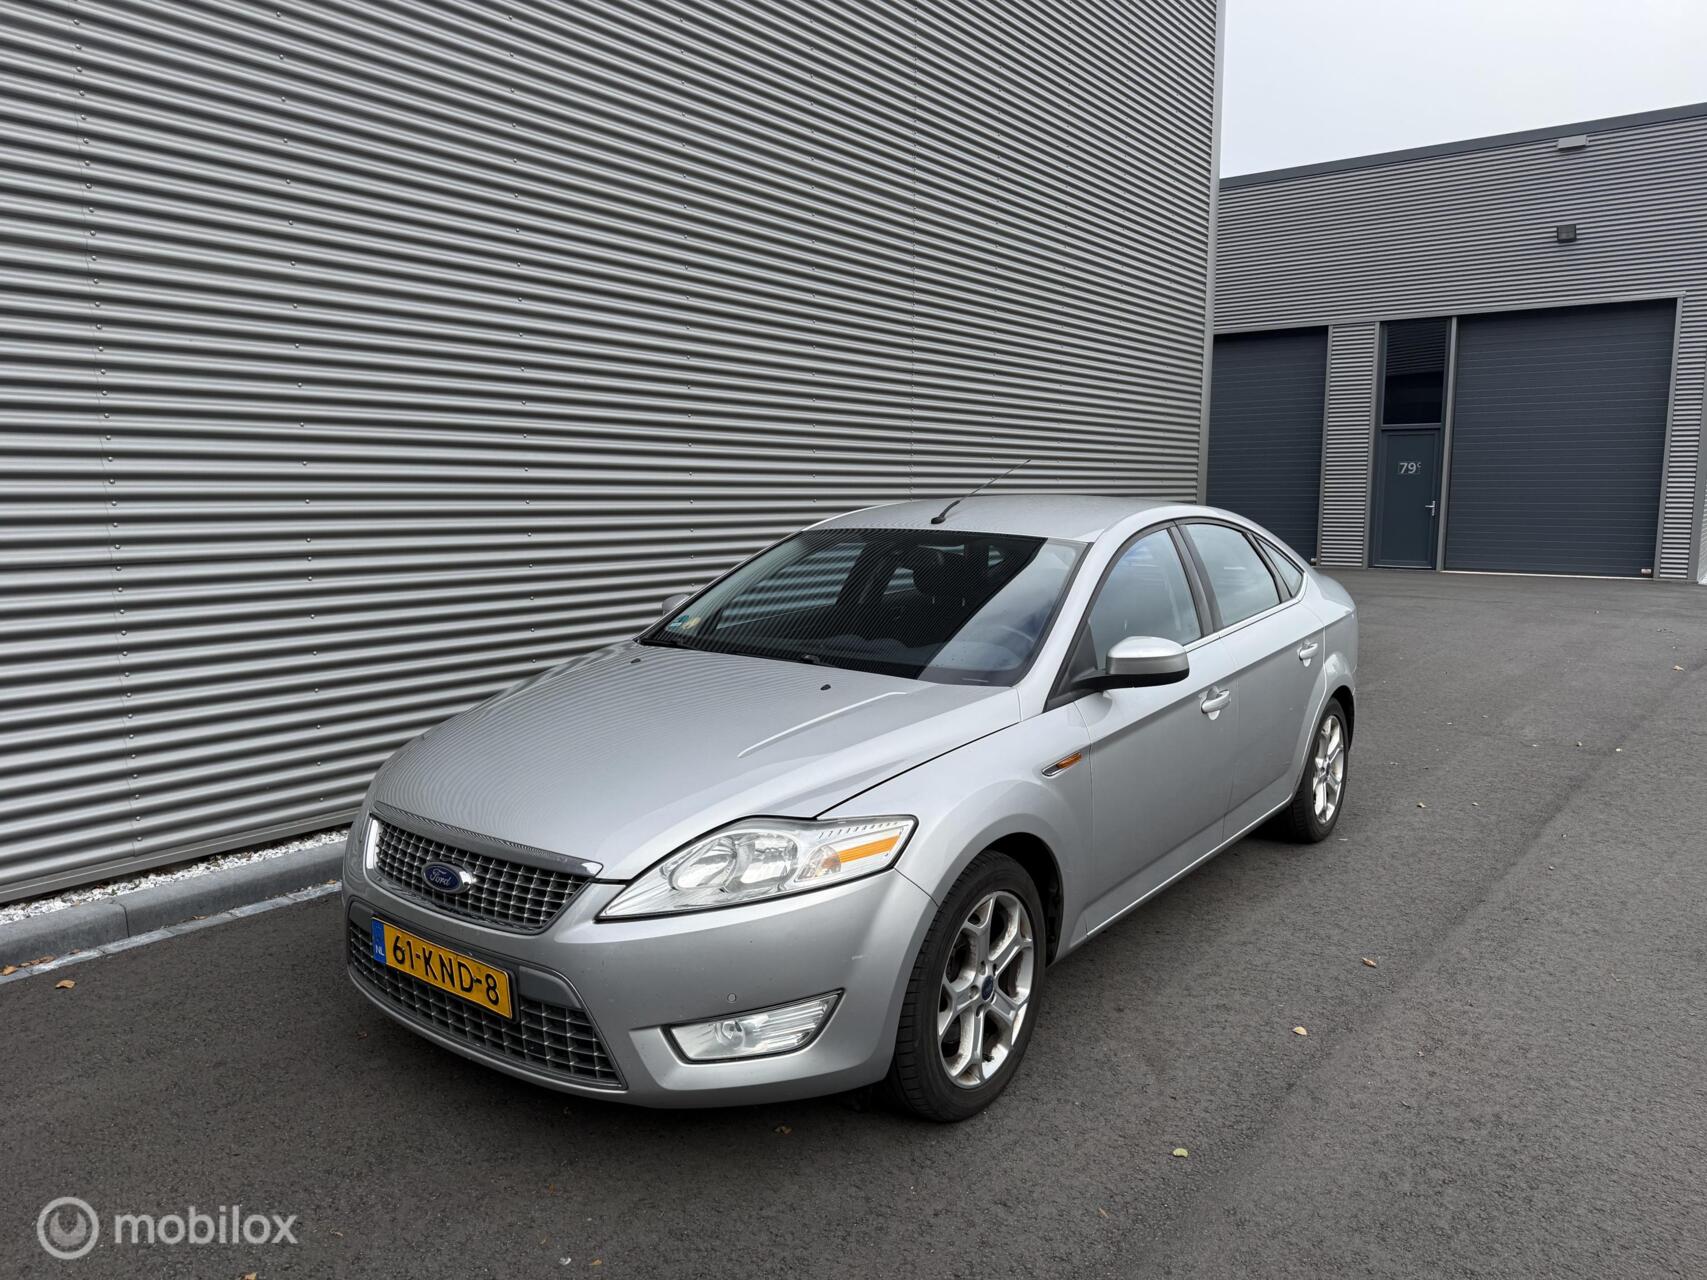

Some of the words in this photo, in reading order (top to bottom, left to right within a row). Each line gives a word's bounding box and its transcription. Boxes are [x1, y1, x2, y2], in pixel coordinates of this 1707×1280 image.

[430, 868, 452, 887] Ford
[375, 944, 385, 957] NL
[393, 935, 500, 1006] 61-KND-8
